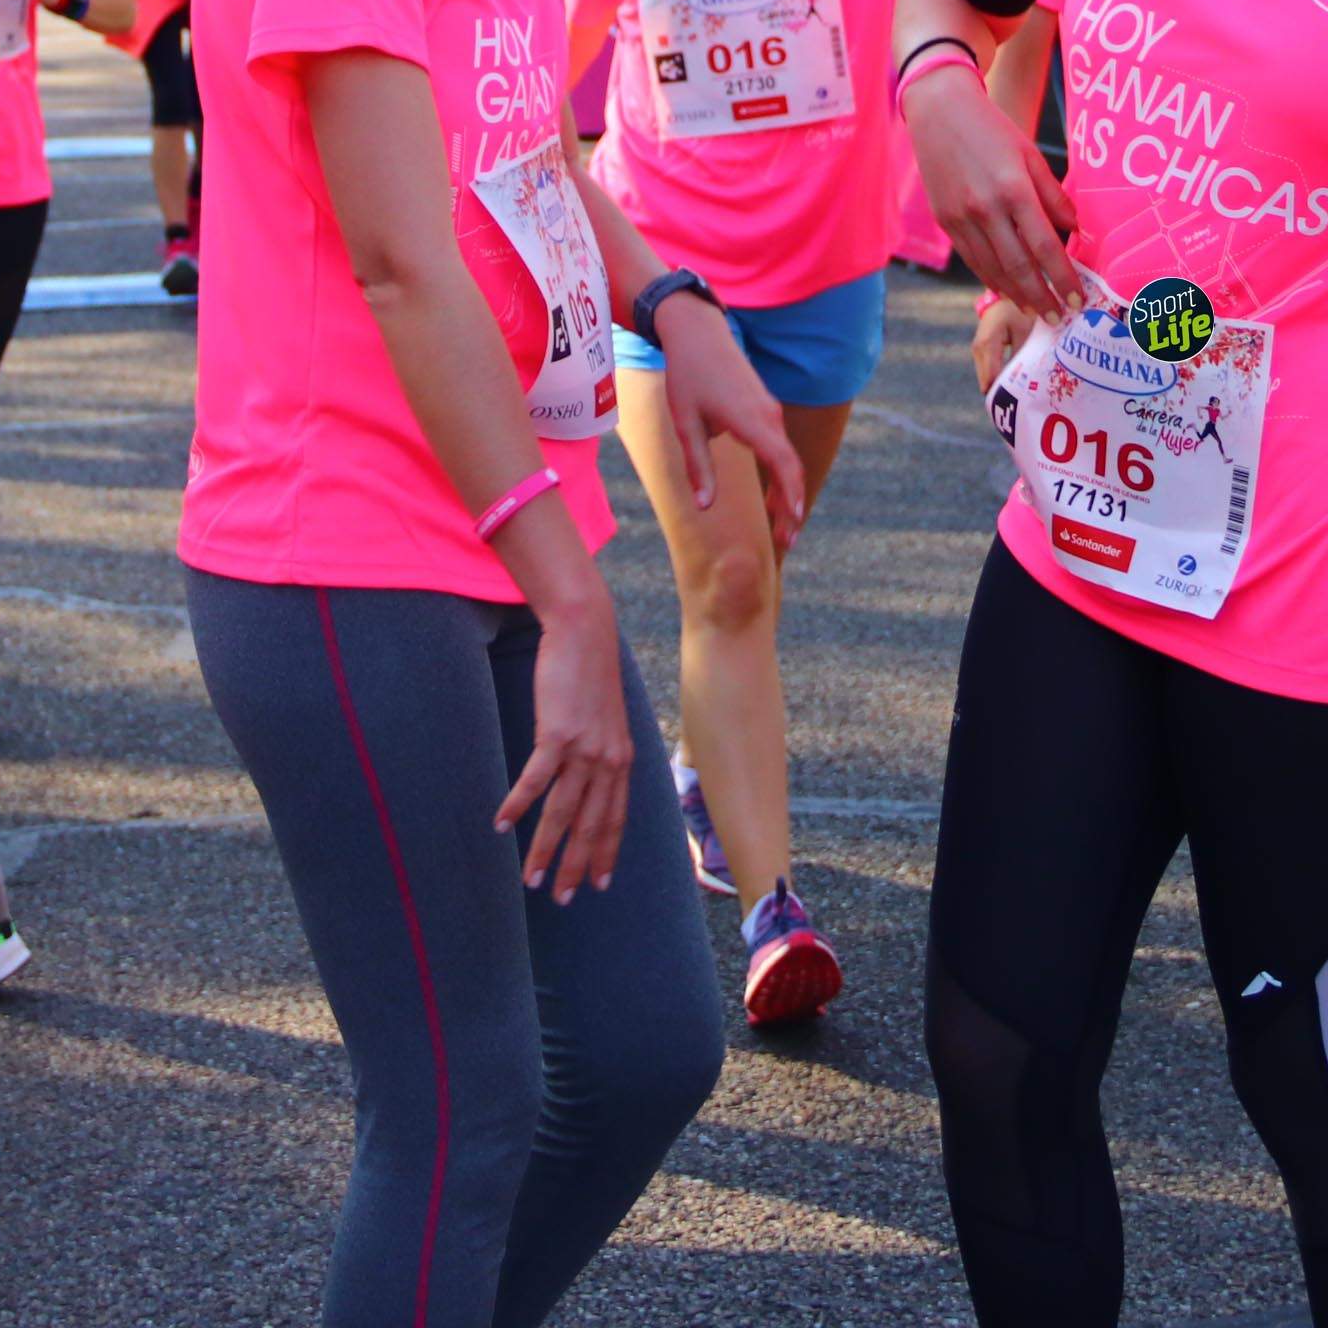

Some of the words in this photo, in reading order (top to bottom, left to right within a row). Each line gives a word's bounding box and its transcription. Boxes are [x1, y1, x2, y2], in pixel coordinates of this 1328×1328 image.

[473, 15, 533, 69] HOY
[706, 36, 788, 76] 016
[724, 75, 776, 96] 21730
[1068, 44, 1235, 150] GANAN
[1072, 108, 1115, 169] AS
[529, 400, 584, 420] OYSHO
[1123, 398, 1183, 428] Carrera
[1039, 412, 1155, 493] 016
[1154, 424, 1205, 457] Mujer
[1053, 478, 1127, 523] 17131
[1071, 533, 1122, 559] Santander
[1154, 574, 1202, 597] ZURICH
